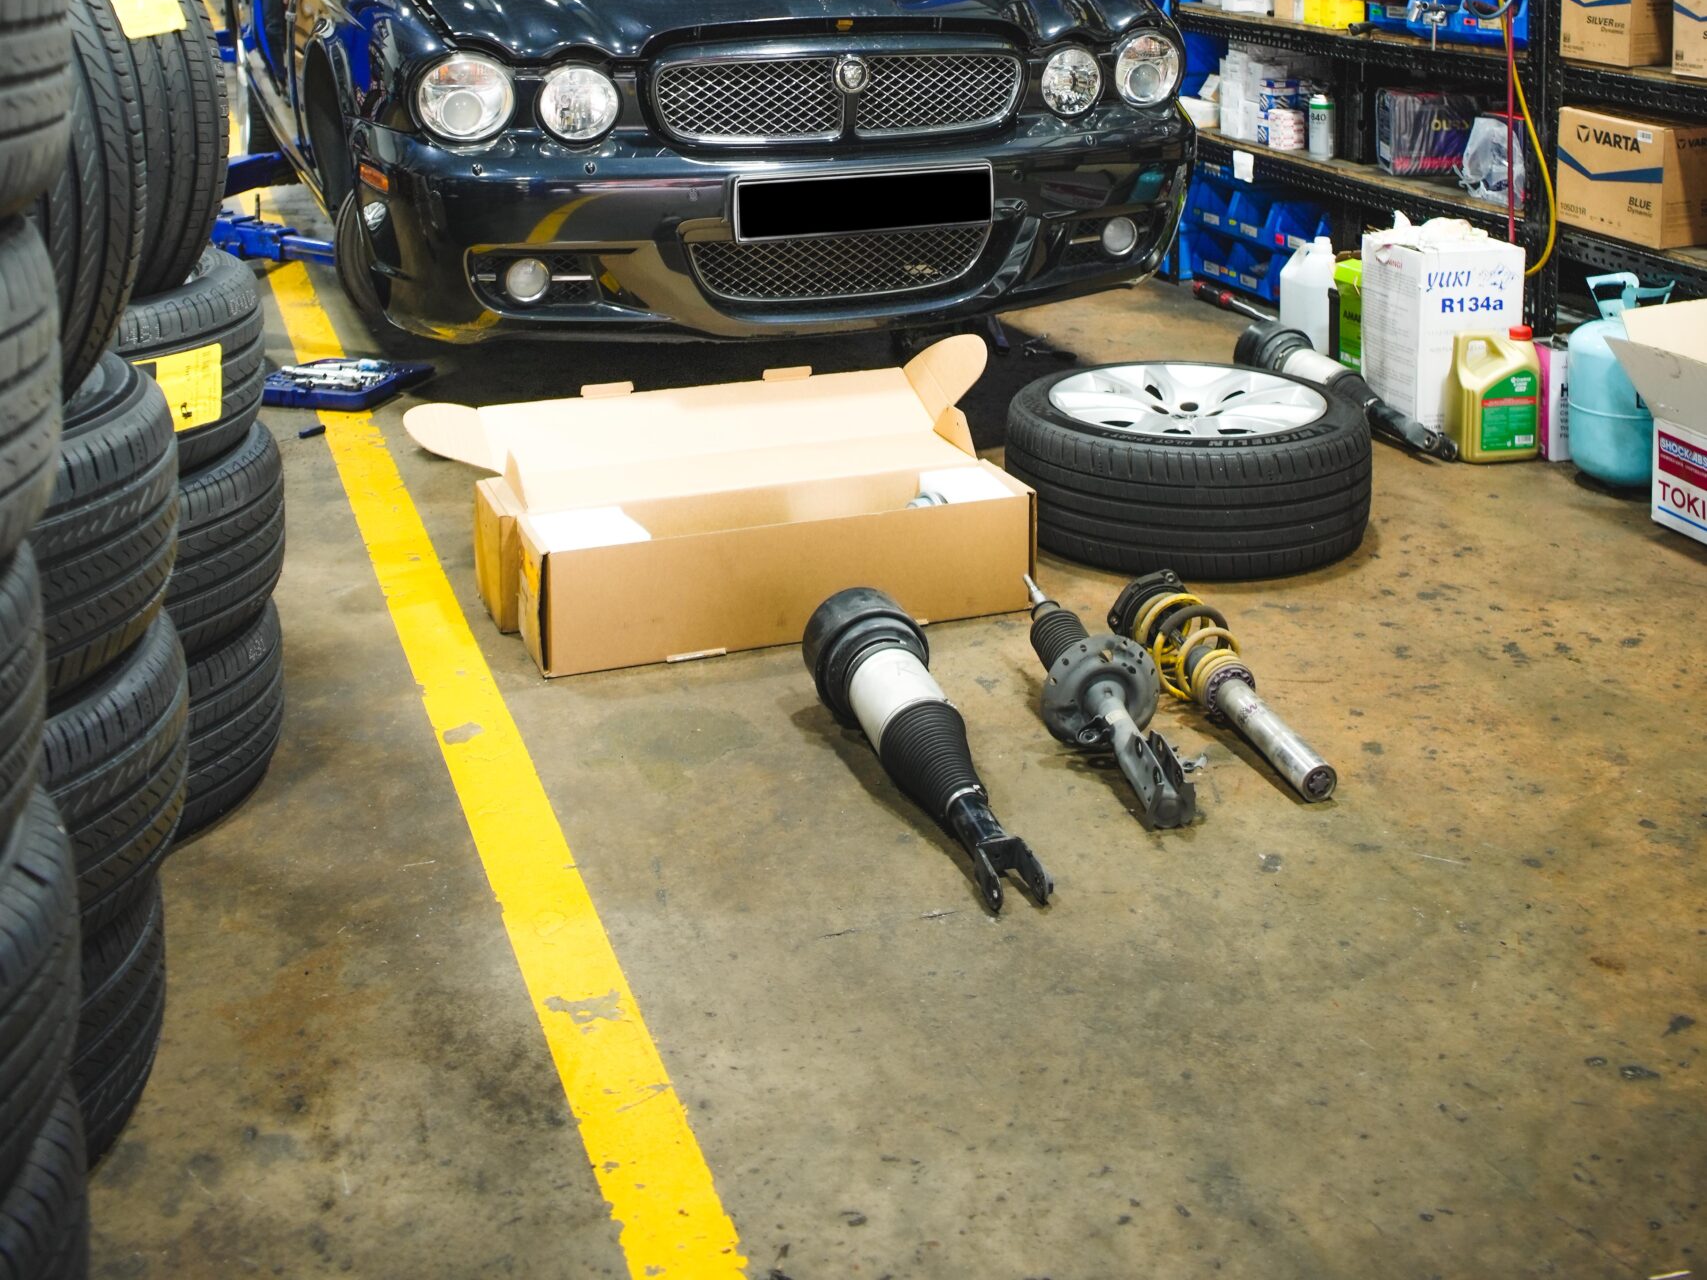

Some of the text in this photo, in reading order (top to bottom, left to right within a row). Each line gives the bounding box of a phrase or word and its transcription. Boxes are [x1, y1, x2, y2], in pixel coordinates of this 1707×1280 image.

[1586, 15, 1614, 27] SILVER
[1593, 128, 1641, 154] VARTA
[1628, 196, 1652, 210] BLUE
[1627, 206, 1653, 218] Dynamic
[1441, 296, 1504, 313] R134a
[1208, 428, 1315, 447] MICHELIN
[1658, 480, 1706, 521] TOKI
